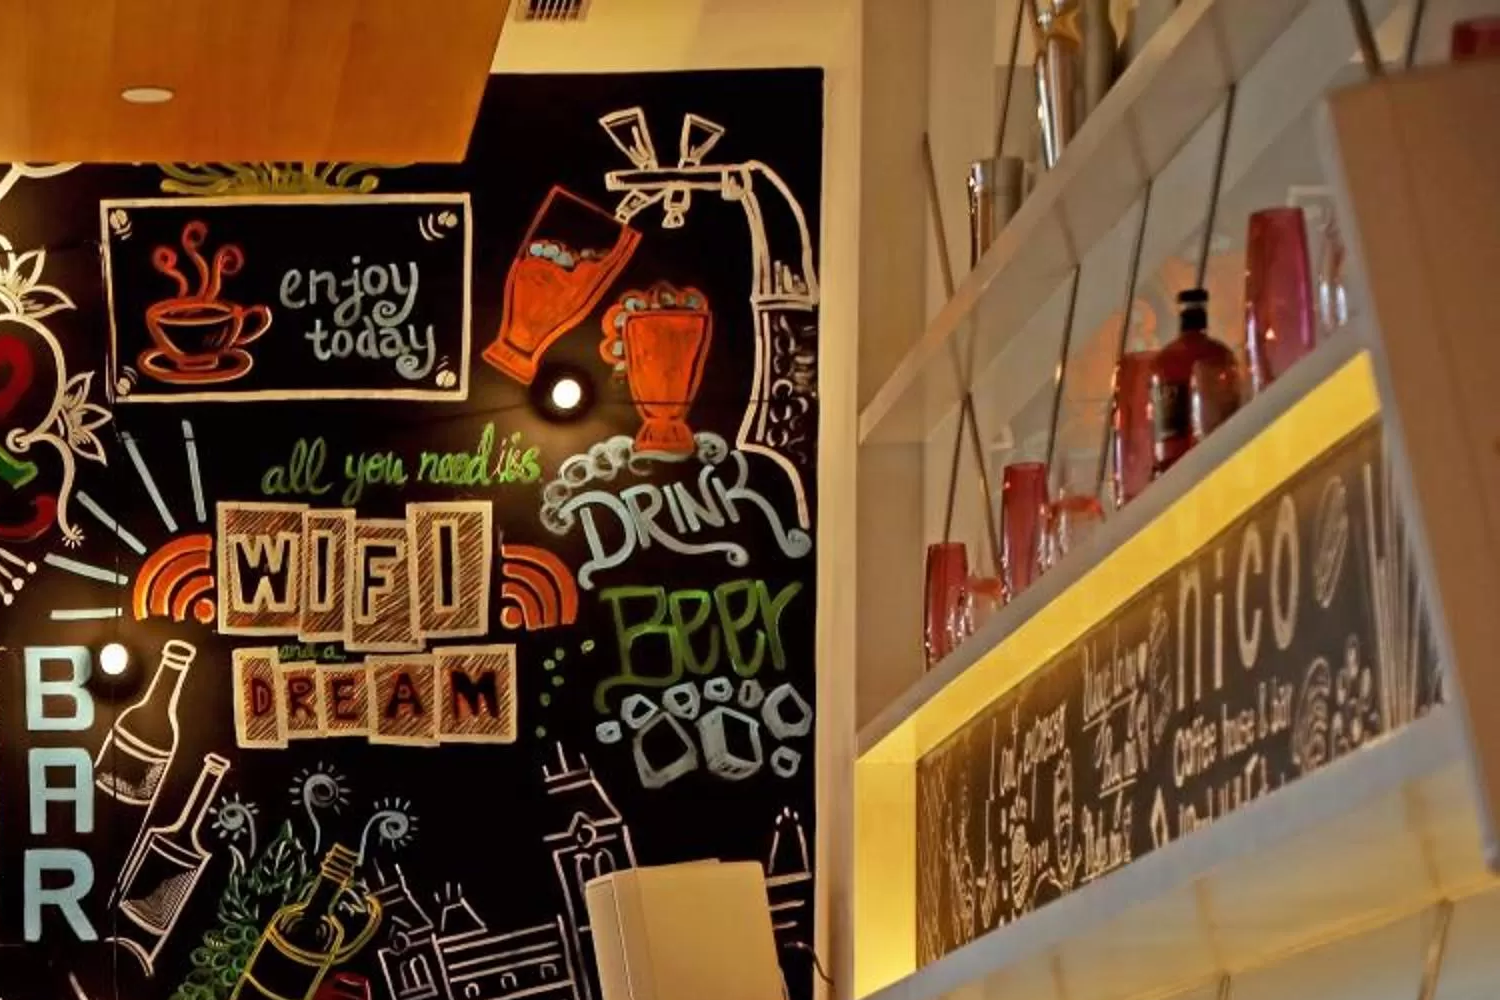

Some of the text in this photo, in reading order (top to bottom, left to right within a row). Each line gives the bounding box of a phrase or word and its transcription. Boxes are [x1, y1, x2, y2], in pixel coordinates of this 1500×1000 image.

[279, 255, 418, 326] enjoy
[305, 316, 436, 380] today
[261, 422, 542, 507] all you need is
[560, 450, 812, 590] DRINK
[228, 518, 459, 625] WIFI
[1177, 494, 1300, 712] nico
[250, 670, 501, 721] DREAM
[22, 645, 99, 943] BAR
